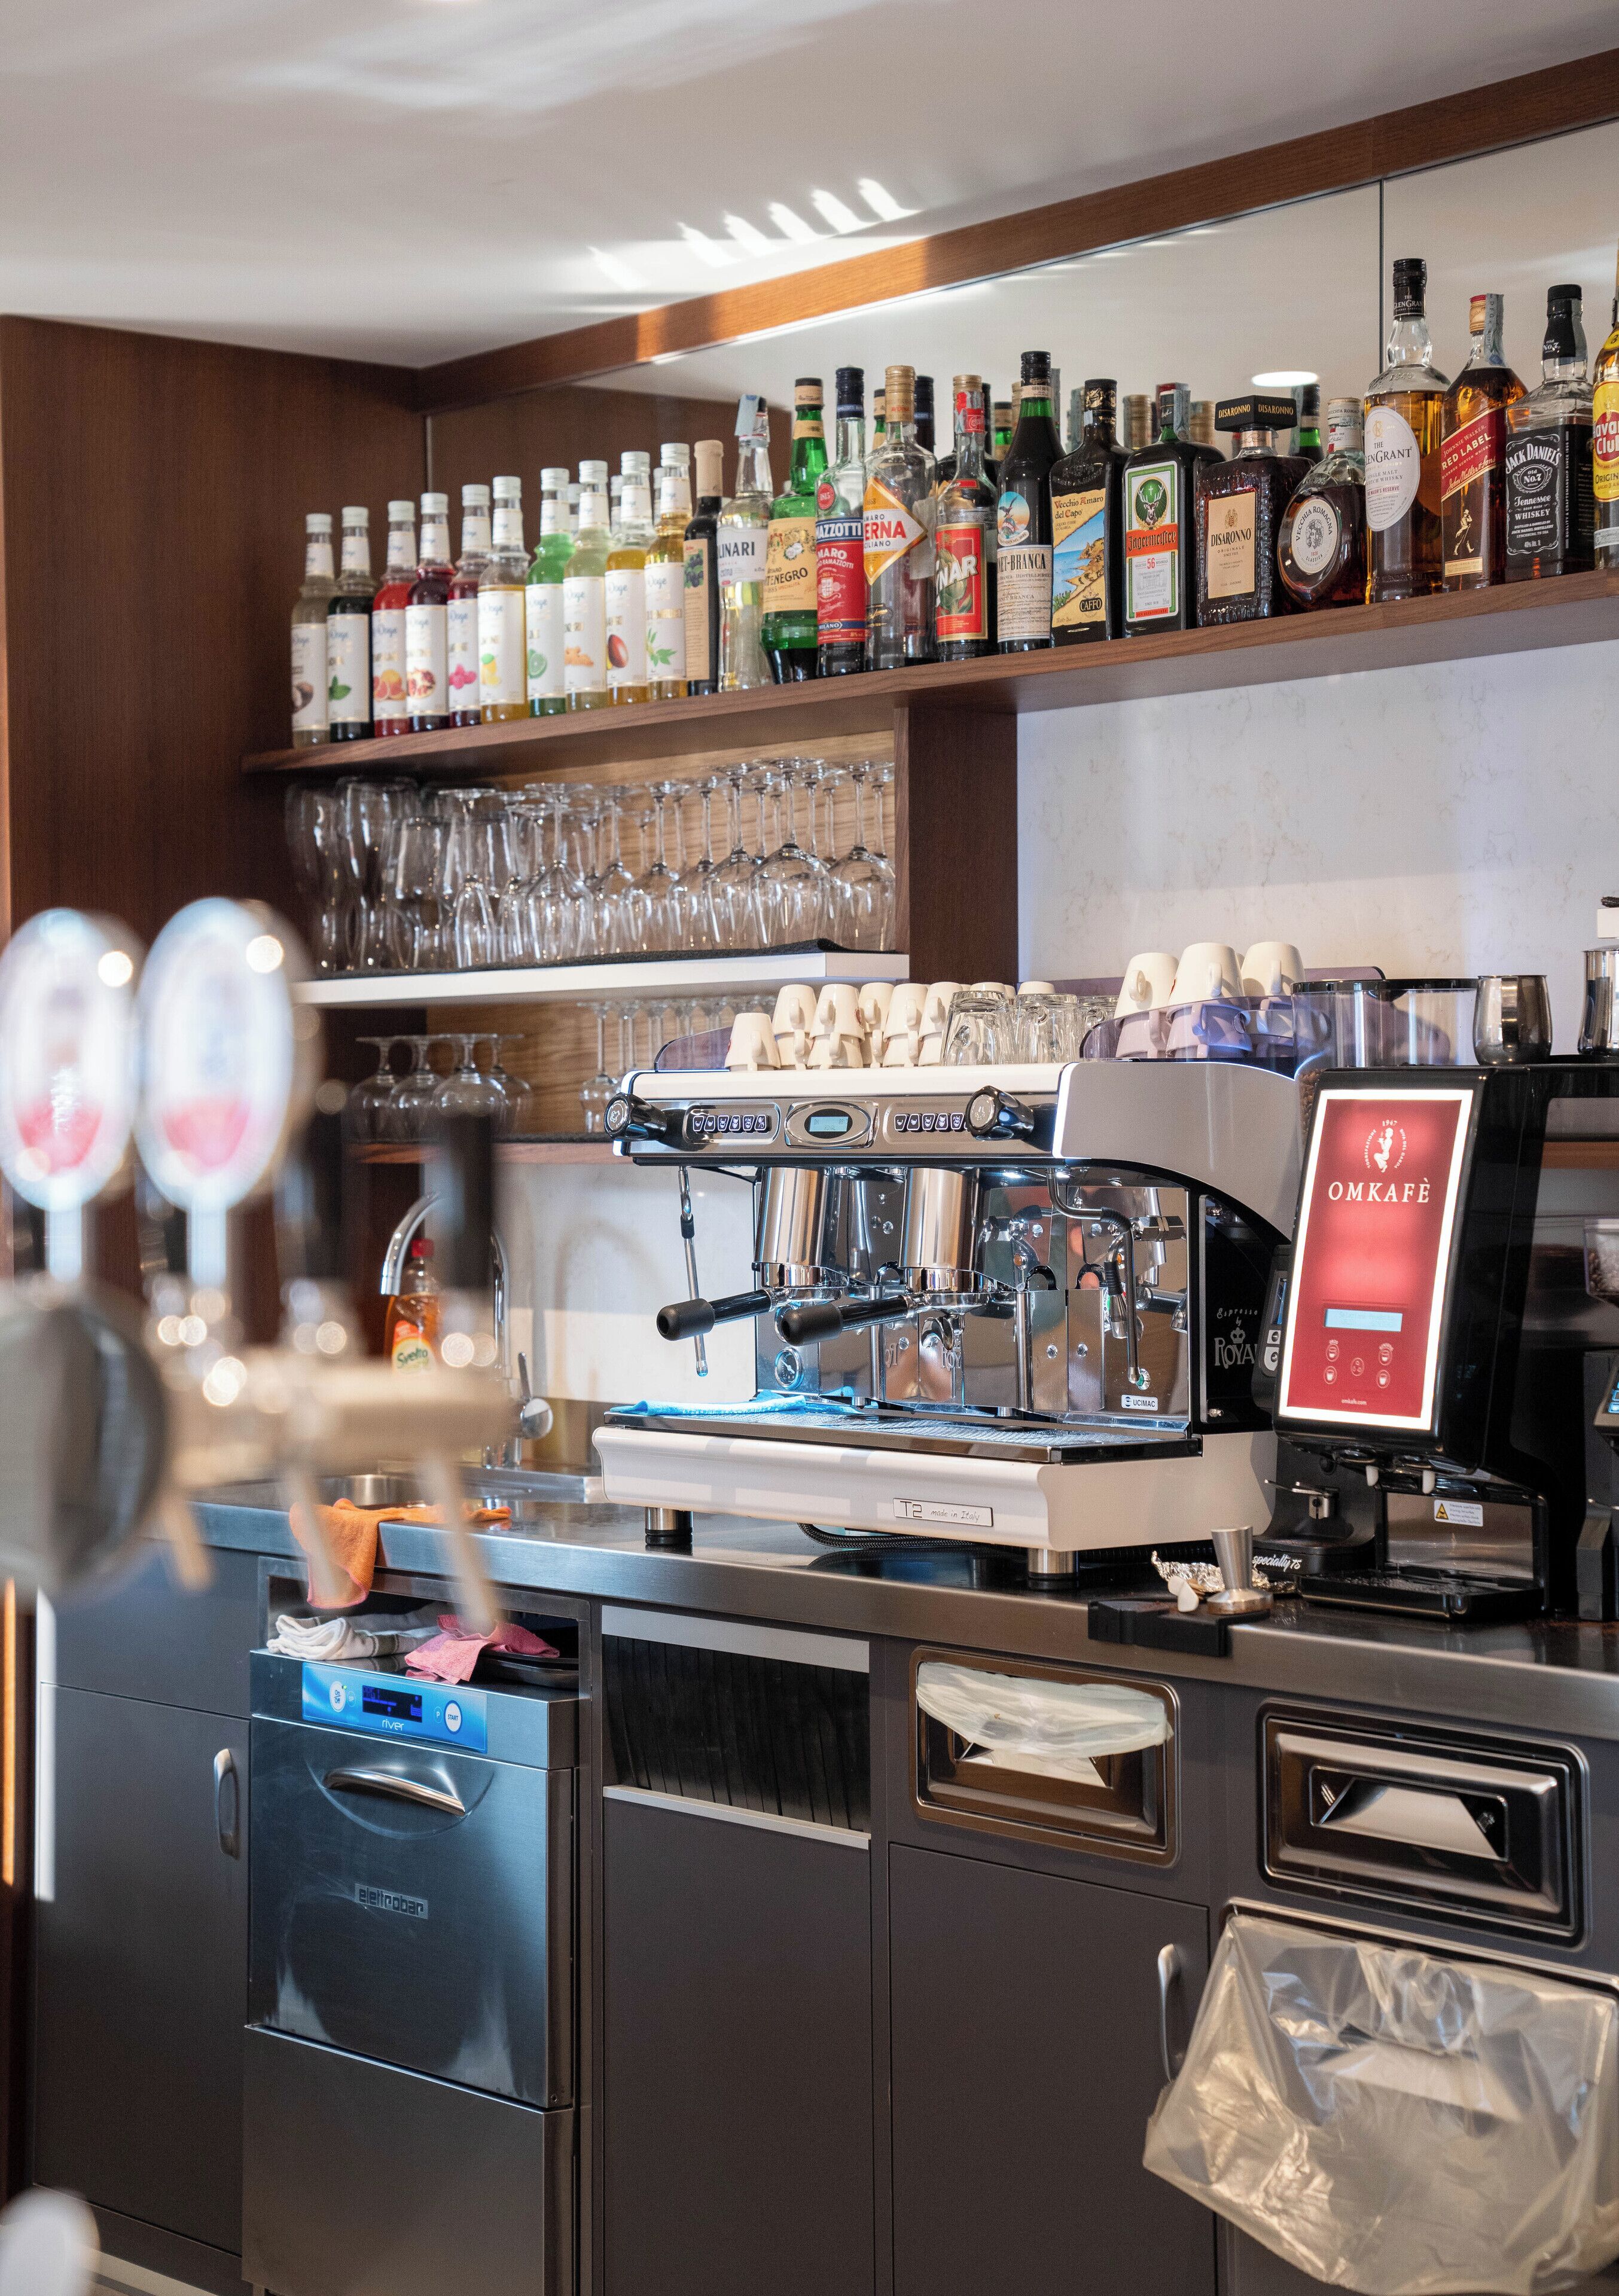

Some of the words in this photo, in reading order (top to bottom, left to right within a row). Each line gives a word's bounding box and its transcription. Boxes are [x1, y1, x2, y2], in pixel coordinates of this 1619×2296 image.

[1218, 404, 1251, 419] DISARONNO
[1258, 404, 1294, 416] DISARONNO
[1443, 439, 1464, 457] JOHNNIE
[1463, 425, 1486, 441] WALKER
[1441, 454, 1459, 470] RED
[1460, 432, 1492, 457] LABEL
[1506, 448, 1527, 474] JACK
[1526, 443, 1562, 466] DANIEL'S
[1380, 474, 1403, 483] WHISKY
[1382, 469, 1398, 477] MALT
[1523, 473, 1542, 484] No.7
[1054, 498, 1079, 509] Vecchio
[1080, 496, 1103, 505] Amaro
[1514, 494, 1551, 507] Tennessee
[1055, 510, 1064, 519] del
[1065, 509, 1082, 518] Capo
[1515, 508, 1551, 520] WHISKEY
[1296, 508, 1312, 542] VECCHIA
[1312, 506, 1333, 536] ROMAGNA
[1211, 527, 1252, 547] DISARONNO
[1217, 545, 1245, 554] ORIGINALE
[1147, 557, 1156, 570] 56
[1080, 599, 1102, 611] CAFFO
[1328, 1177, 1431, 1203] OMKAFÈ
[1216, 1307, 1258, 1319] Espresso
[1236, 1316, 1242, 1327] by
[397, 1347, 428, 1369] Svelto
[1132, 1399, 1155, 1408] UCIMAC
[900, 1500, 923, 1518] T2
[931, 1509, 949, 1518] made
[950, 1510, 958, 1518] in
[961, 1510, 980, 1523] Italy
[1252, 1553, 1291, 1573] specialty
[436, 1711, 441, 1720] P
[447, 1713, 459, 1722] START
[382, 1718, 405, 1732] river
[359, 1886, 425, 1916] elettrobar
